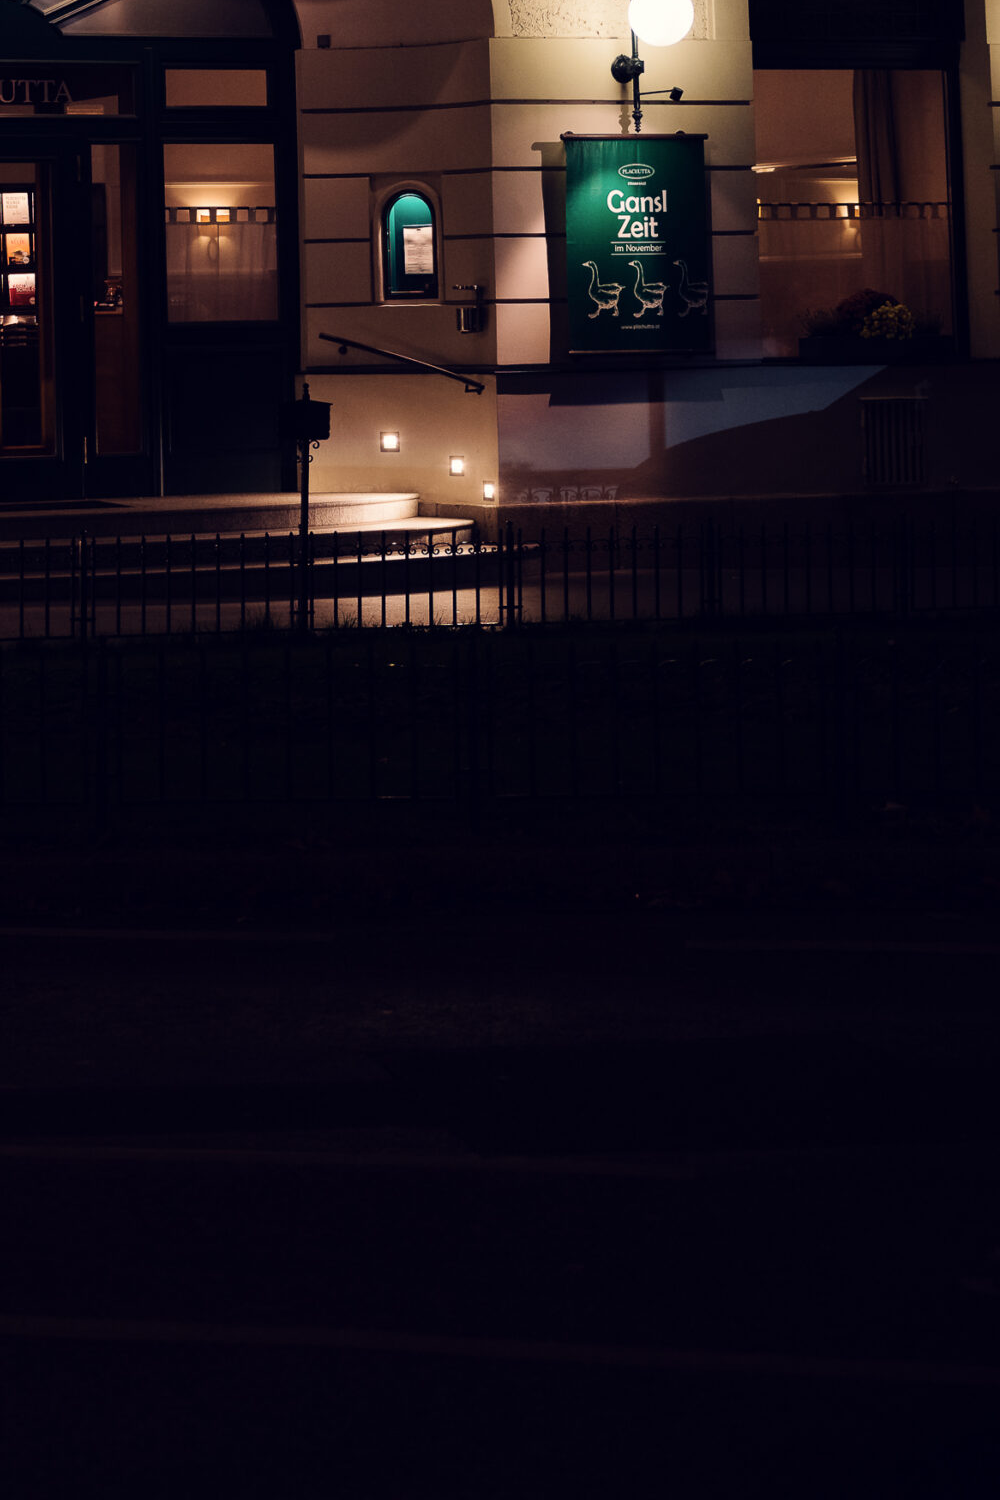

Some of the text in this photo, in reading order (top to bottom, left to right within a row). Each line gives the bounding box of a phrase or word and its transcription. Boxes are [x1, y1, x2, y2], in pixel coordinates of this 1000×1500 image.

[606, 189, 668, 213] Gansl
[617, 215, 659, 238] Zeit
[614, 243, 663, 253] im November
